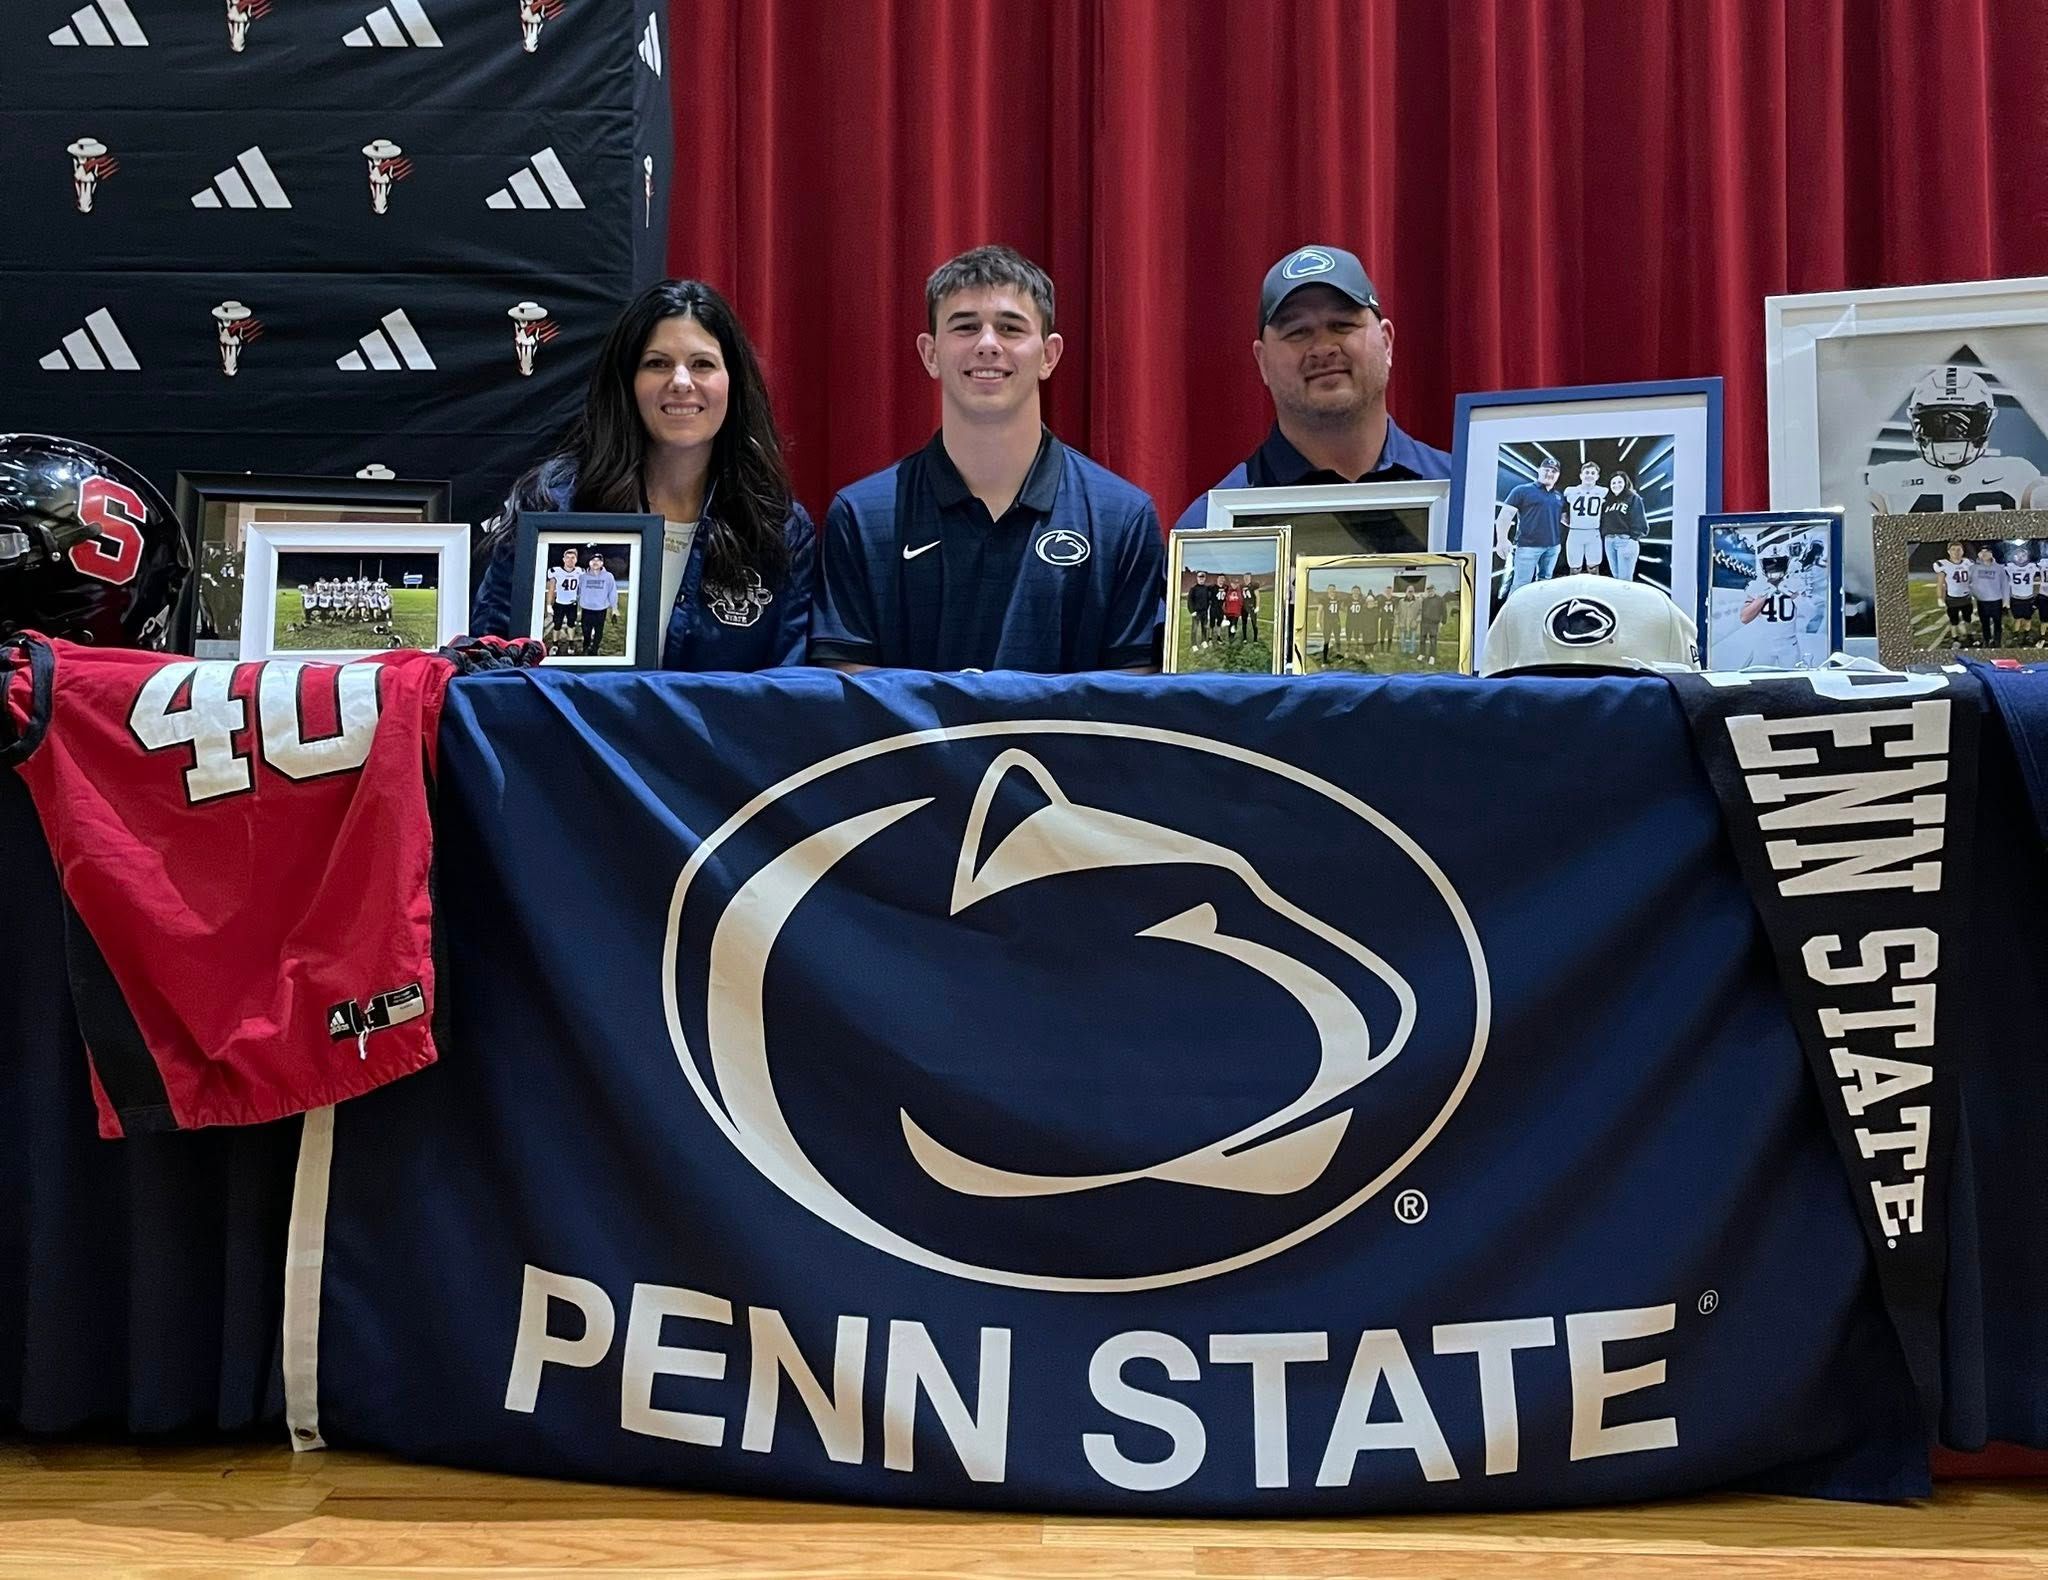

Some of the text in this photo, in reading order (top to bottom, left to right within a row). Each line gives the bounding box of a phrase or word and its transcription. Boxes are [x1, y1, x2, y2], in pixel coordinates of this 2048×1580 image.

[1573, 496, 1601, 516] 40
[69, 475, 147, 585] S
[561, 579, 578, 591] 40
[1952, 571, 1969, 583] 40
[2012, 573, 2031, 585] 54
[1760, 595, 1796, 622] 40
[128, 661, 384, 803] 40
[1802, 926, 1939, 1236] STATE
[505, 1263, 1011, 1483] PENN
[1083, 1302, 1679, 1490] STATE
